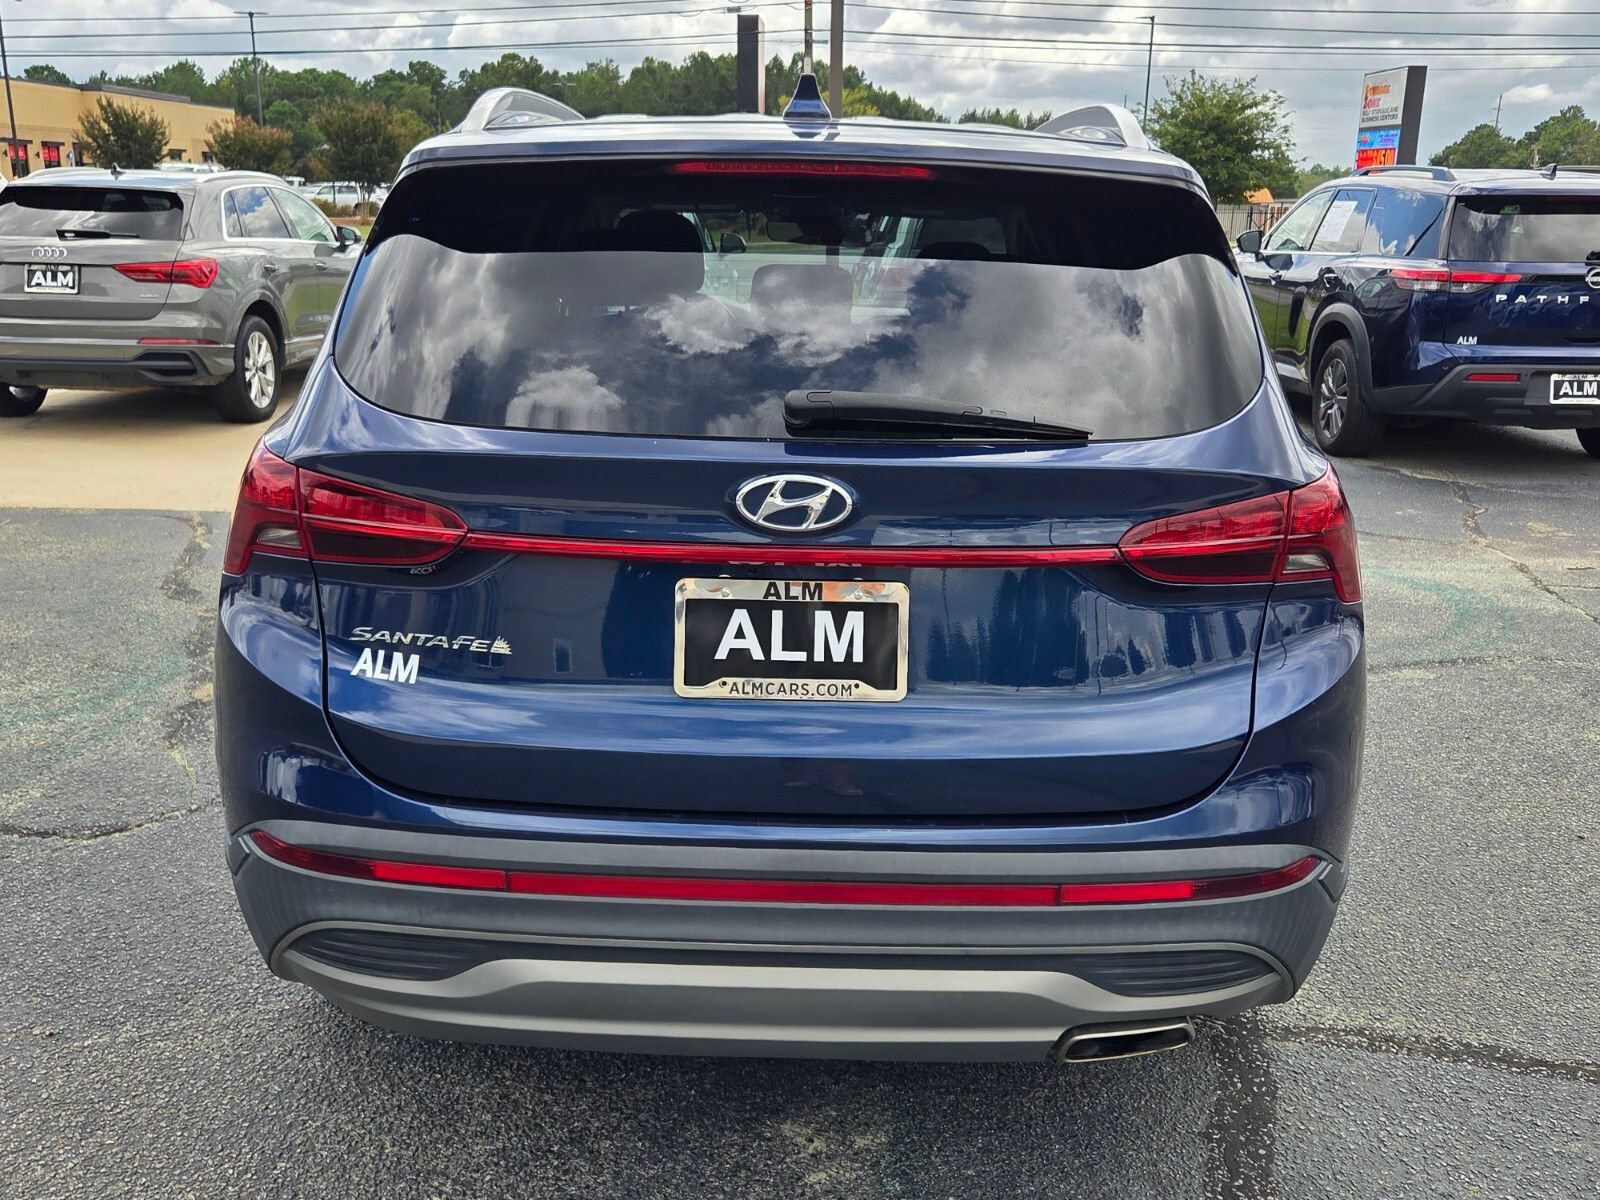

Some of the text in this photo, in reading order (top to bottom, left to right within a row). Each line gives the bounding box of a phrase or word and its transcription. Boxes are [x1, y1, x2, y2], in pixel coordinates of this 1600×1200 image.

[30, 270, 74, 287] ALM
[1495, 294, 1590, 304] PATHF
[1457, 336, 1478, 345] ALM
[1559, 381, 1598, 396] ALM
[762, 581, 823, 601] ALM
[713, 608, 865, 663] ALM
[350, 647, 421, 685] ALM
[729, 681, 853, 697] ALMCARS.COM
